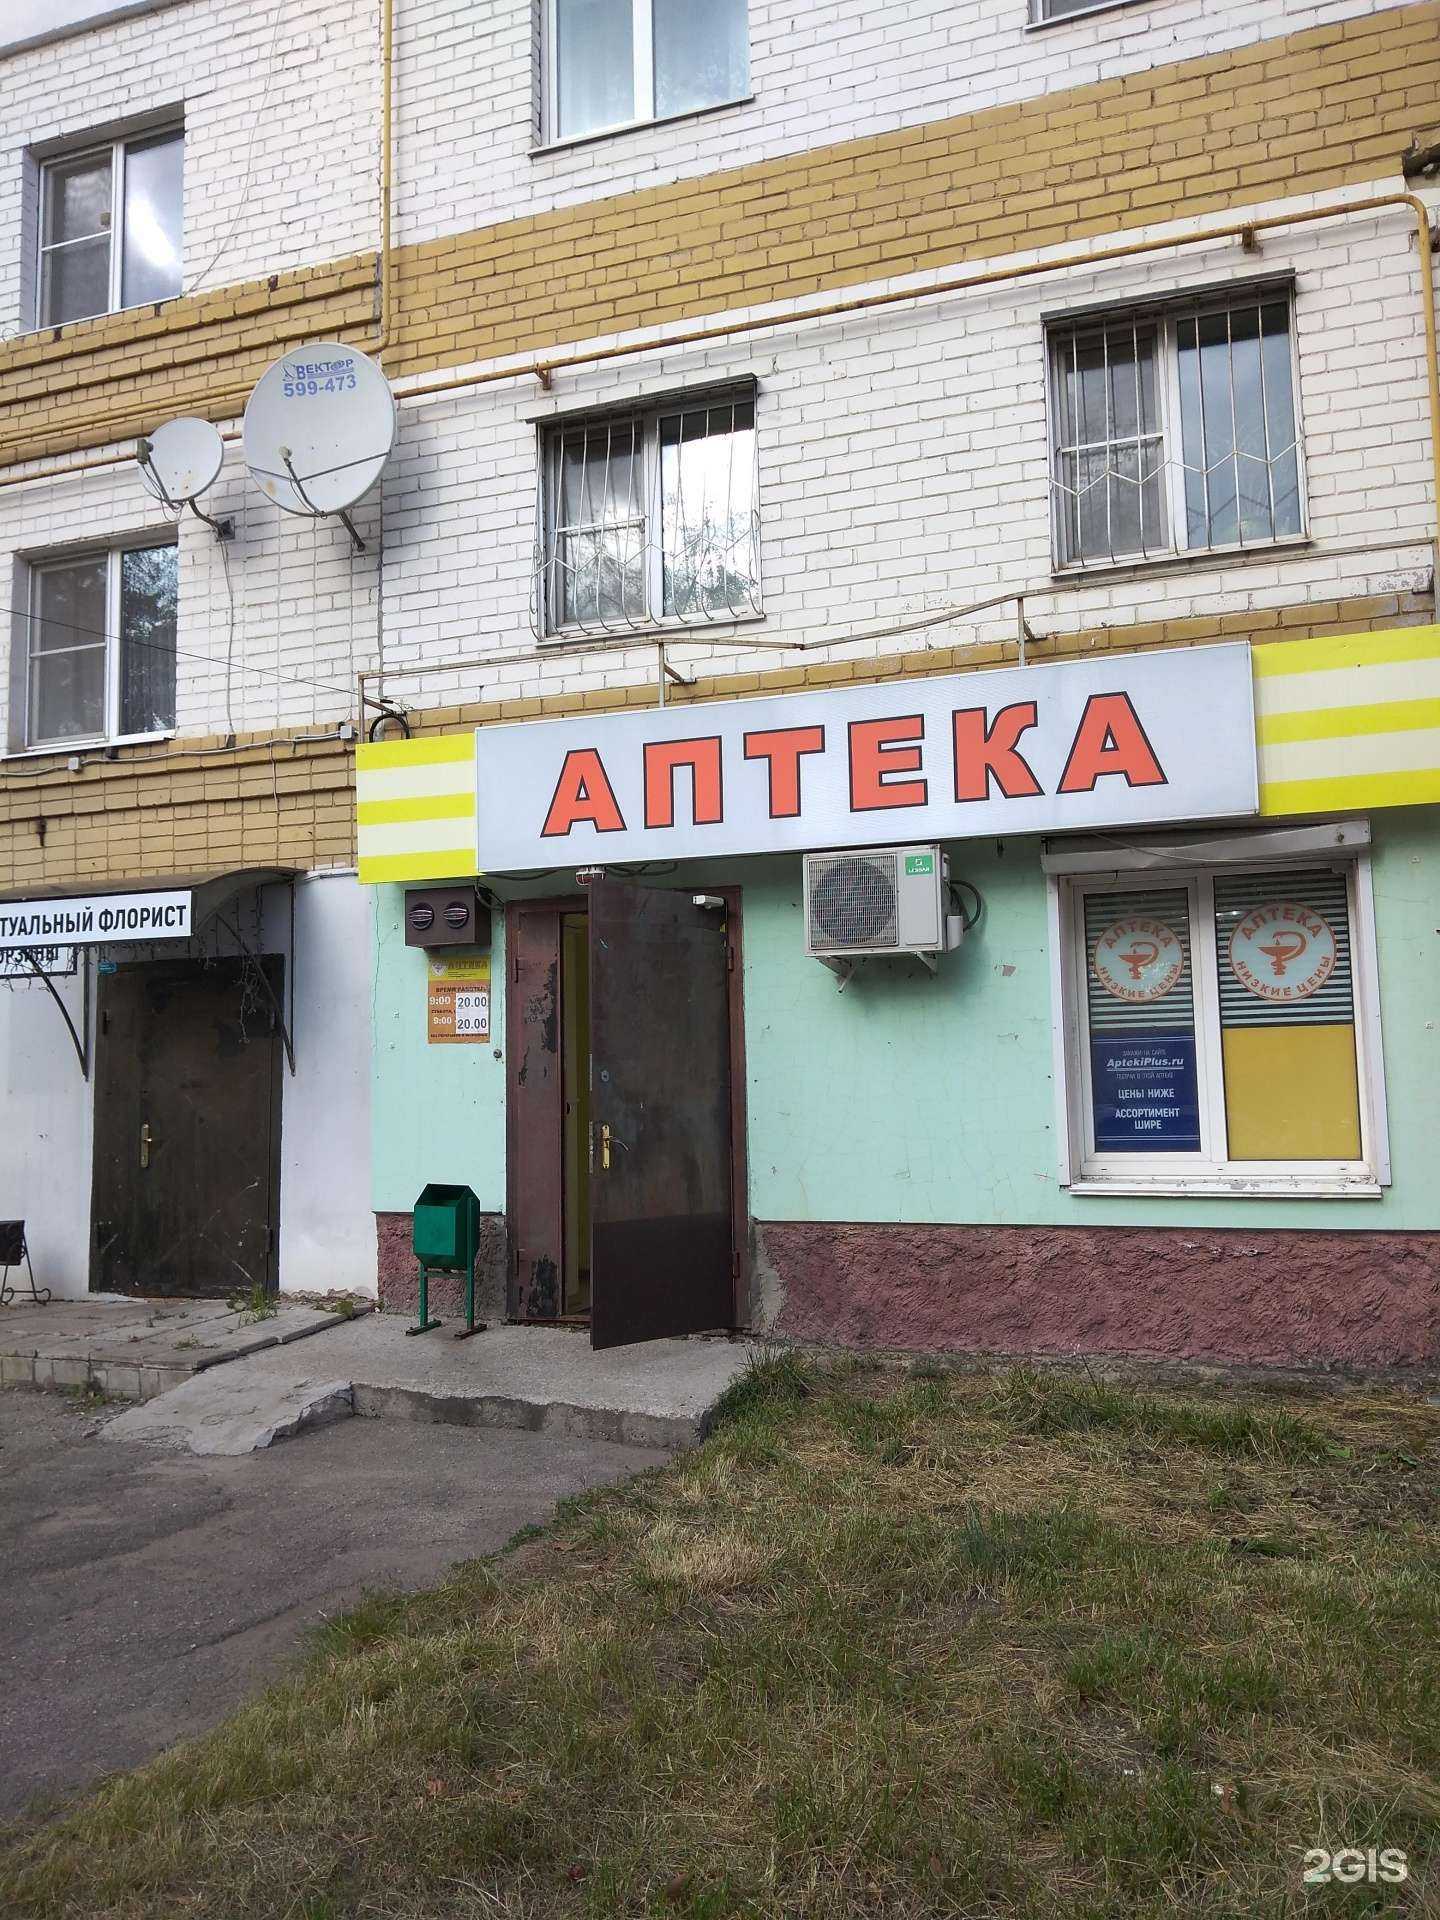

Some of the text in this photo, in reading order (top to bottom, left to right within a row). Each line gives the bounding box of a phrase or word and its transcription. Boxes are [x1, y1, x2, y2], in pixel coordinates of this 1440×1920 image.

[284, 374, 356, 397] 599-473
[540, 691, 1168, 838] АПТЕКА
[99, 905, 187, 932] ФЛОРИСТ
[1241, 908, 1323, 940] АПТЕКА
[1105, 922, 1173, 949] АПТЕКА
[1099, 966, 1145, 999] НИЗКИЕ
[1236, 956, 1332, 997] НИЗКИЕ ЦЕНЫ
[457, 997, 487, 1008] 20.00
[457, 1018, 487, 1029] 20.00
[1106, 1058, 1184, 1069] AptekiPlus.ru
[1118, 1088, 1175, 1100] ЦЕНЫ НИЖЕ
[1115, 1108, 1180, 1118] АССОРТИМЕНТ
[1134, 1120, 1162, 1129] ШИРЕ
